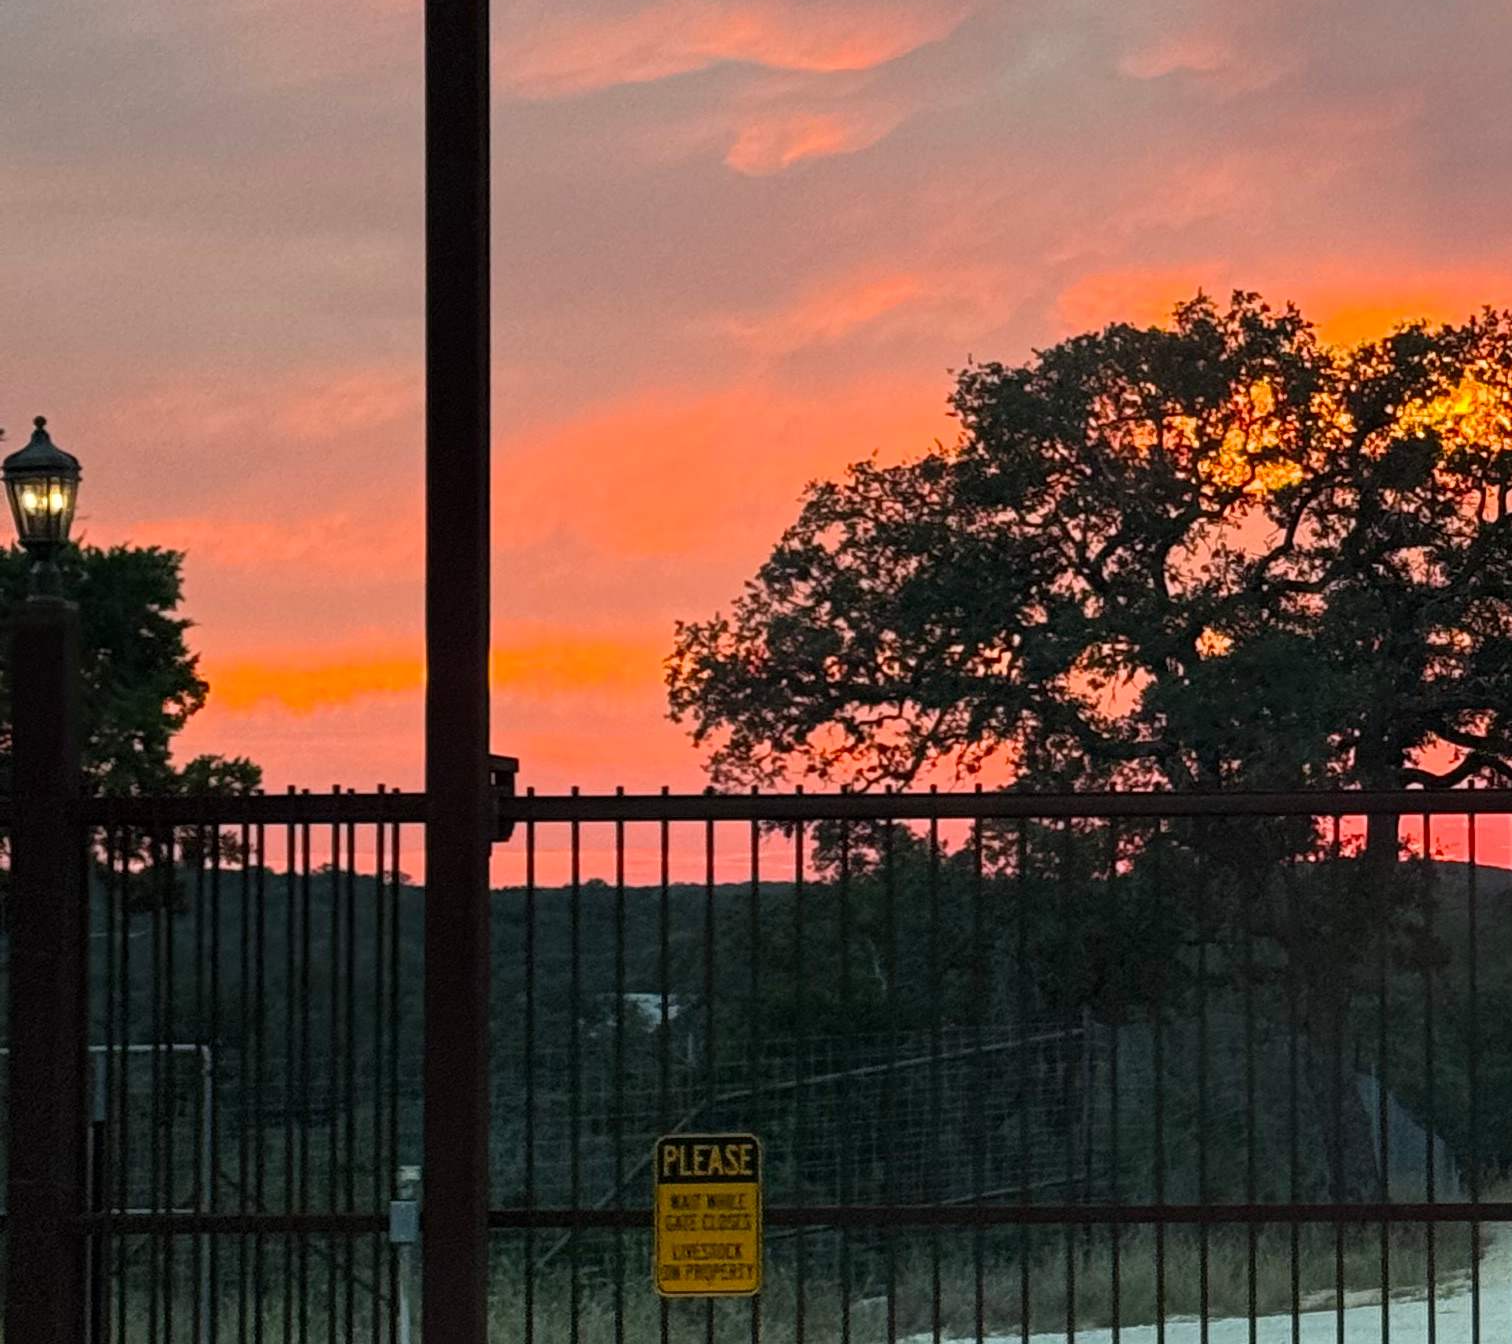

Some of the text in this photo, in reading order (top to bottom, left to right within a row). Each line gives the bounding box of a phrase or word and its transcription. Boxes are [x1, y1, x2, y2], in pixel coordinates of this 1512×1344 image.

[663, 1144, 753, 1177] PLEASE
[670, 1194, 701, 1210] WAIT
[665, 1214, 698, 1231] GATE
